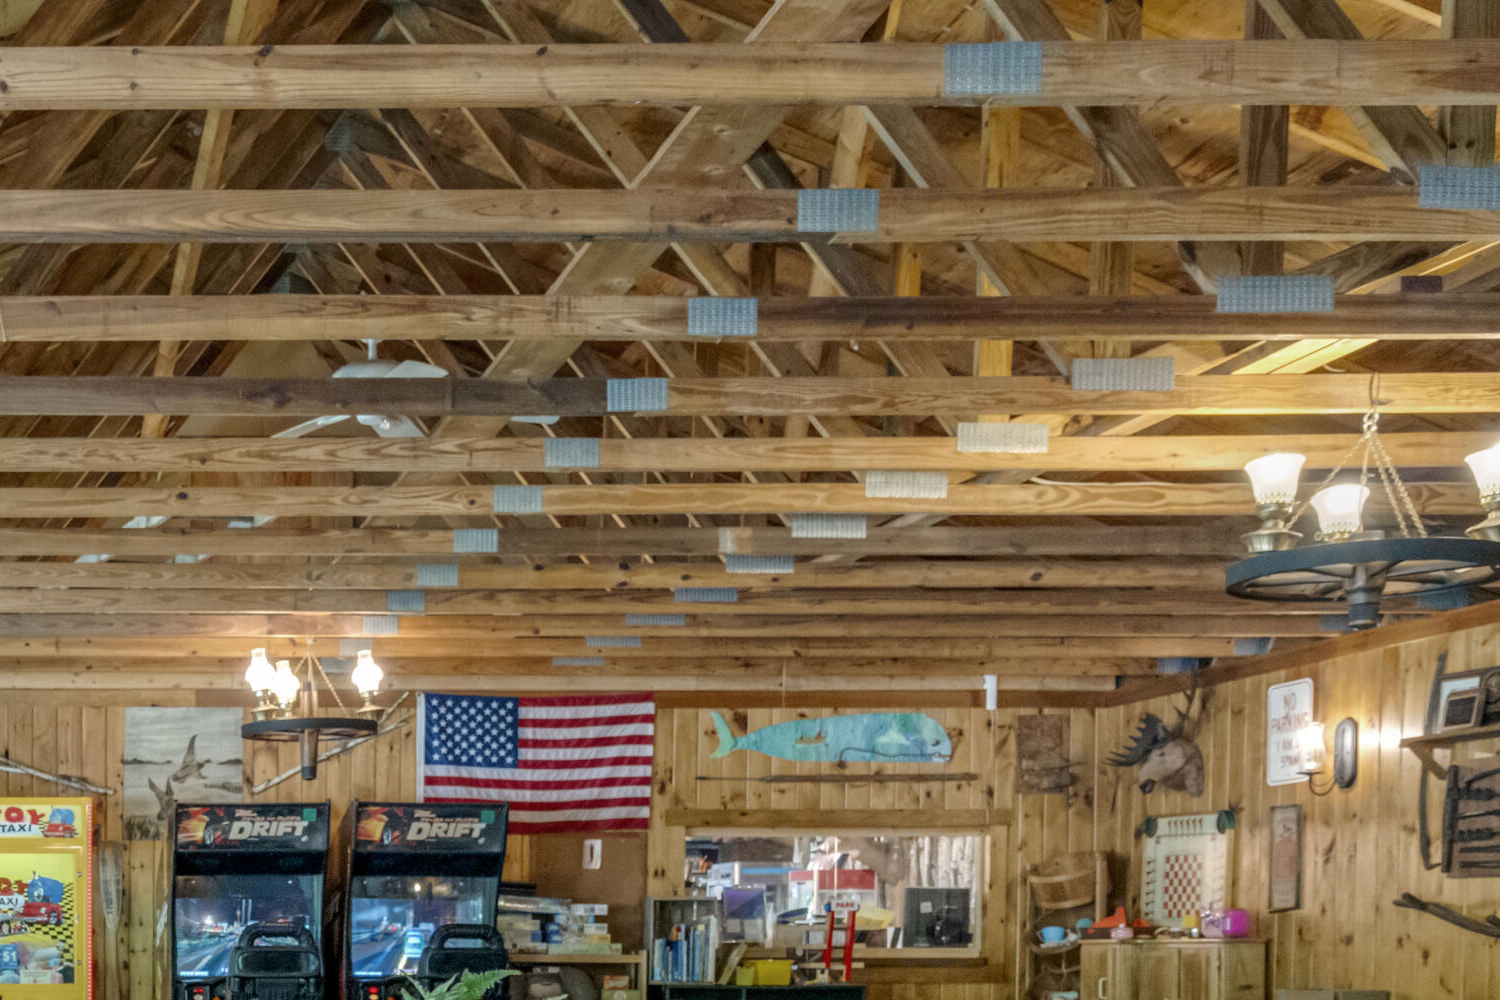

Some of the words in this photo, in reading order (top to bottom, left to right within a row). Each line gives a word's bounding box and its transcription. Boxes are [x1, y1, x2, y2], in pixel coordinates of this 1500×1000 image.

[1283, 691, 1297, 711] NO
[0, 824, 32, 833] TAXI
[228, 820, 309, 840] DRIFT
[406, 821, 486, 841] DRIFT
